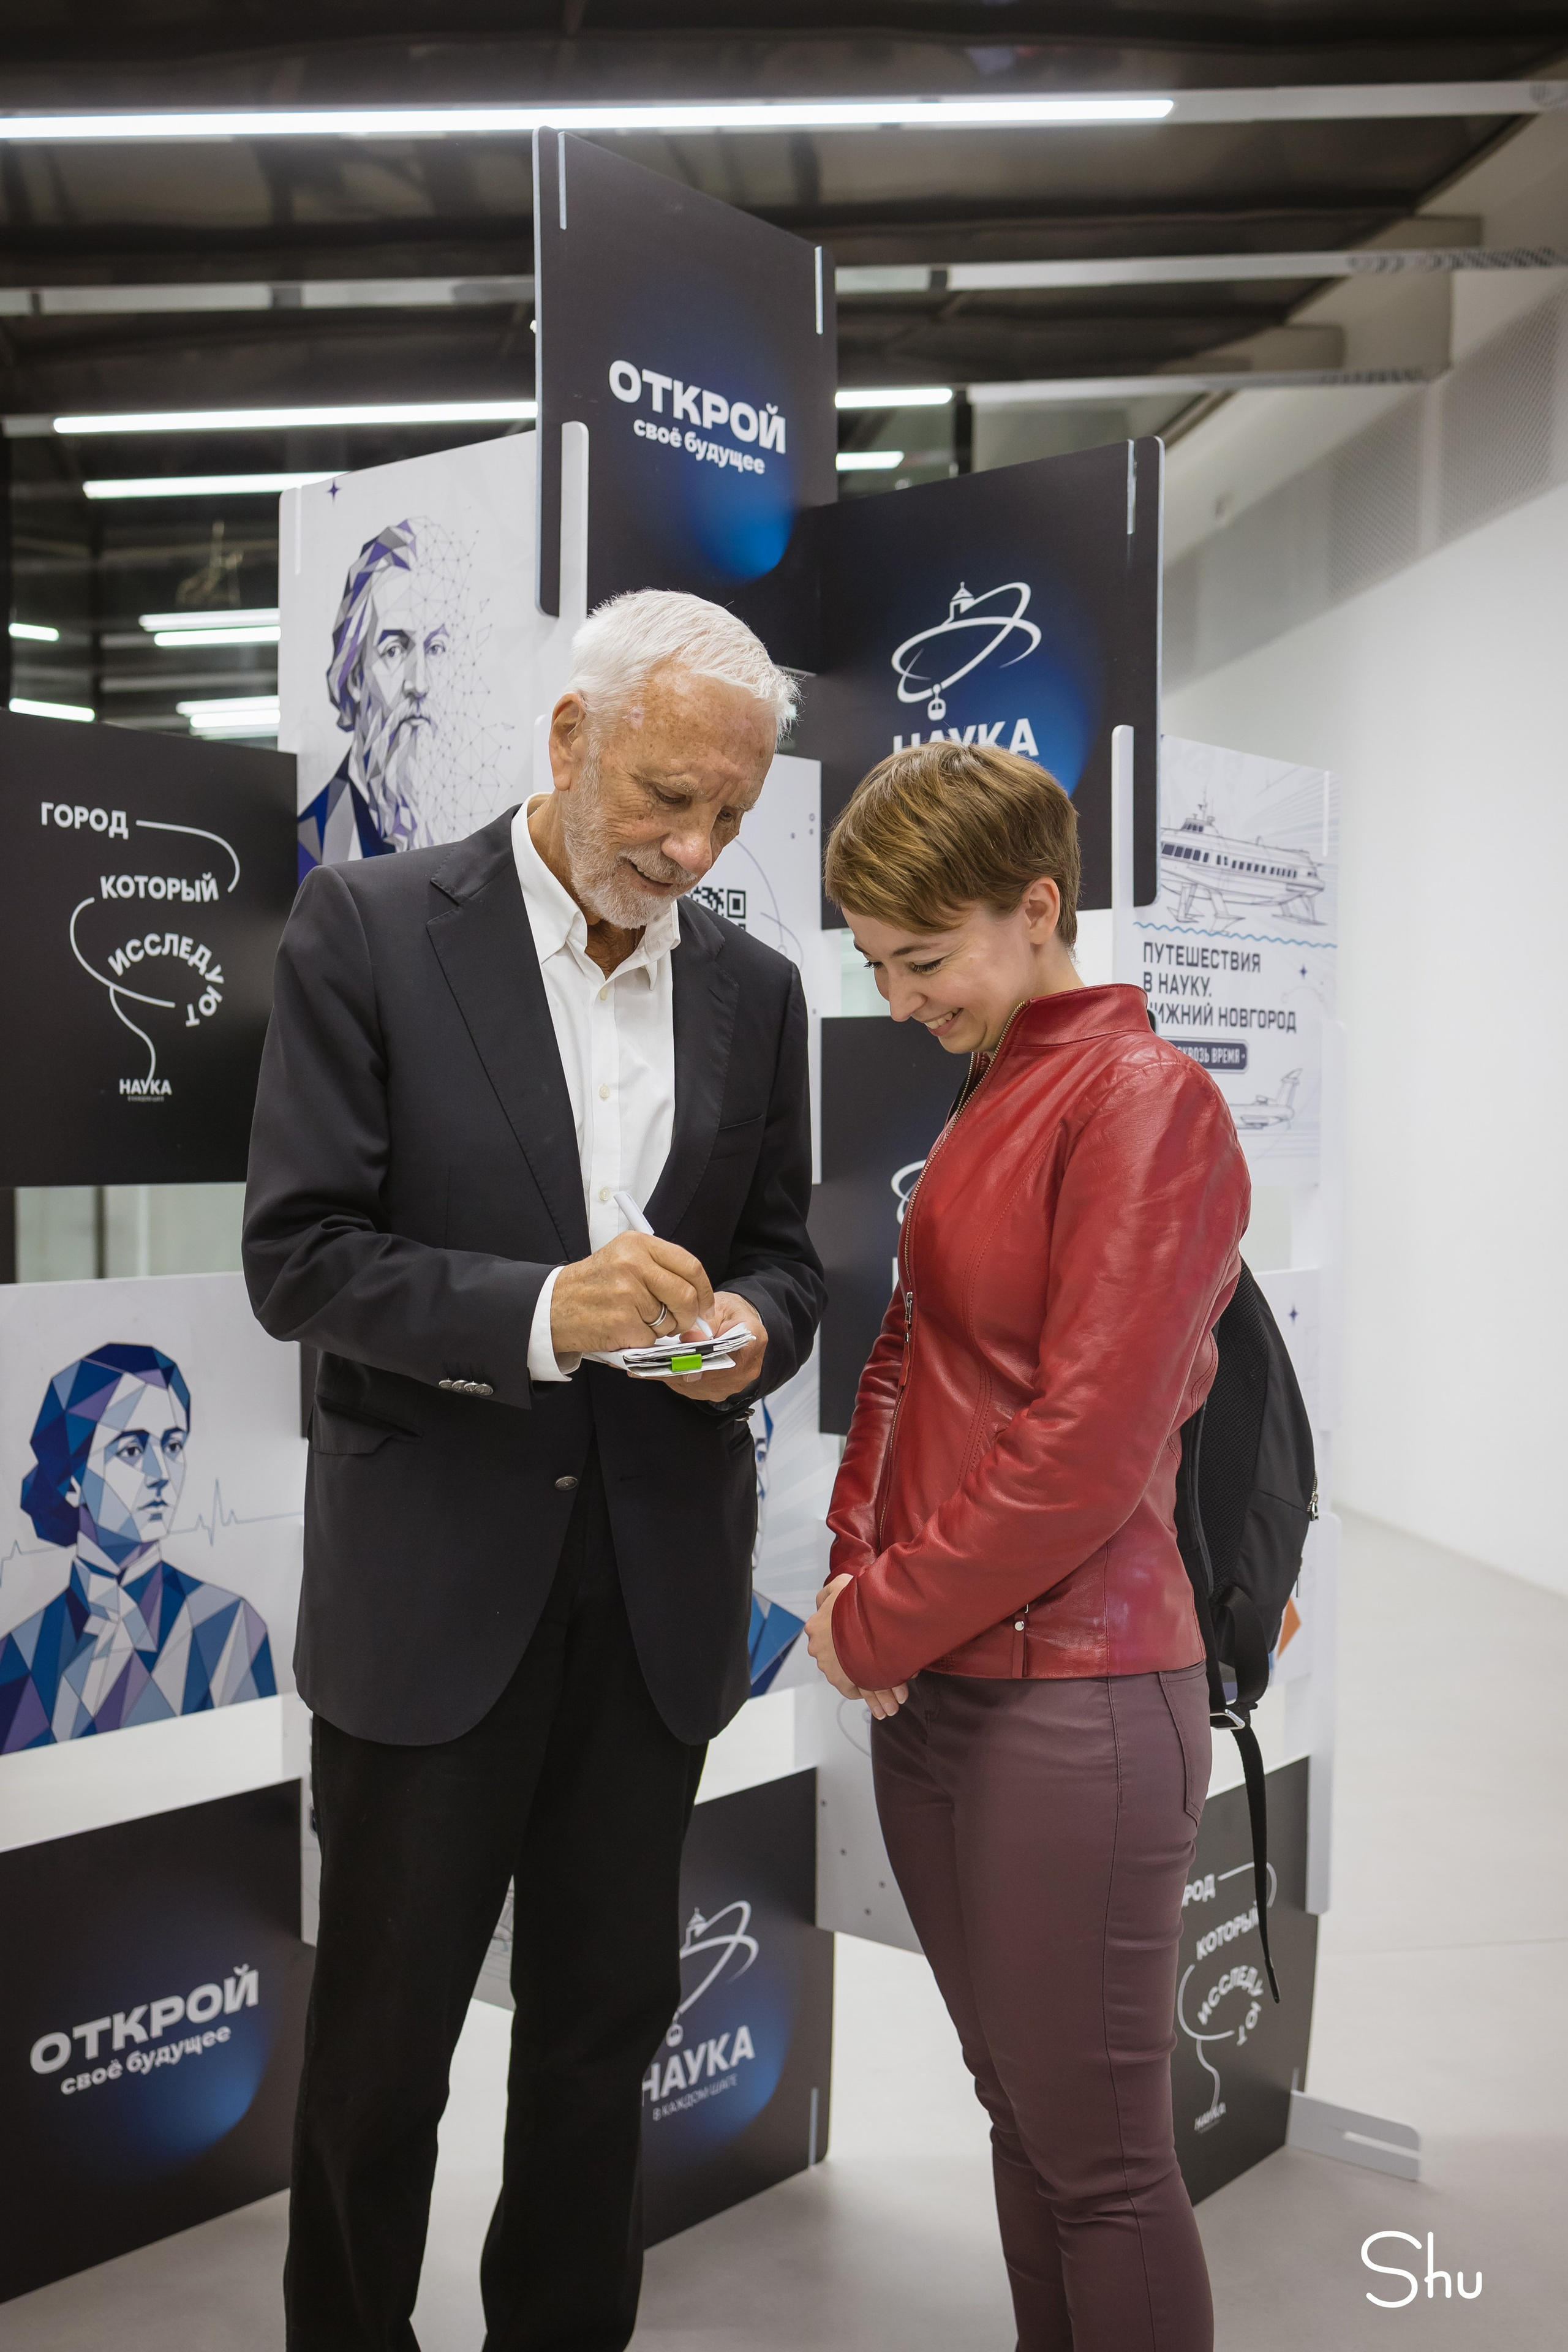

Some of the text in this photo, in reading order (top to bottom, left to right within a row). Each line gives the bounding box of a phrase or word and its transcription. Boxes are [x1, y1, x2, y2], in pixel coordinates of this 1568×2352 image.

[609, 360, 786, 454] ОТКРОЙ
[633, 419, 765, 475] своё будущее
[40, 802, 129, 840] ГОРОД
[100, 872, 219, 902] КОТОРЫЙ
[1144, 941, 1261, 973] ПУТЕШЕСТВИЯ
[108, 933, 224, 1027] ИССЛЕДУЮТ
[1144, 971, 1212, 997] В НАУКУ.
[1219, 1007, 1297, 1034] НОВГОРОД
[119, 1079, 173, 1095] НАУКА
[29, 1964, 259, 2075] ОТКРОЙ
[61, 2026, 231, 2095] своё будущее
